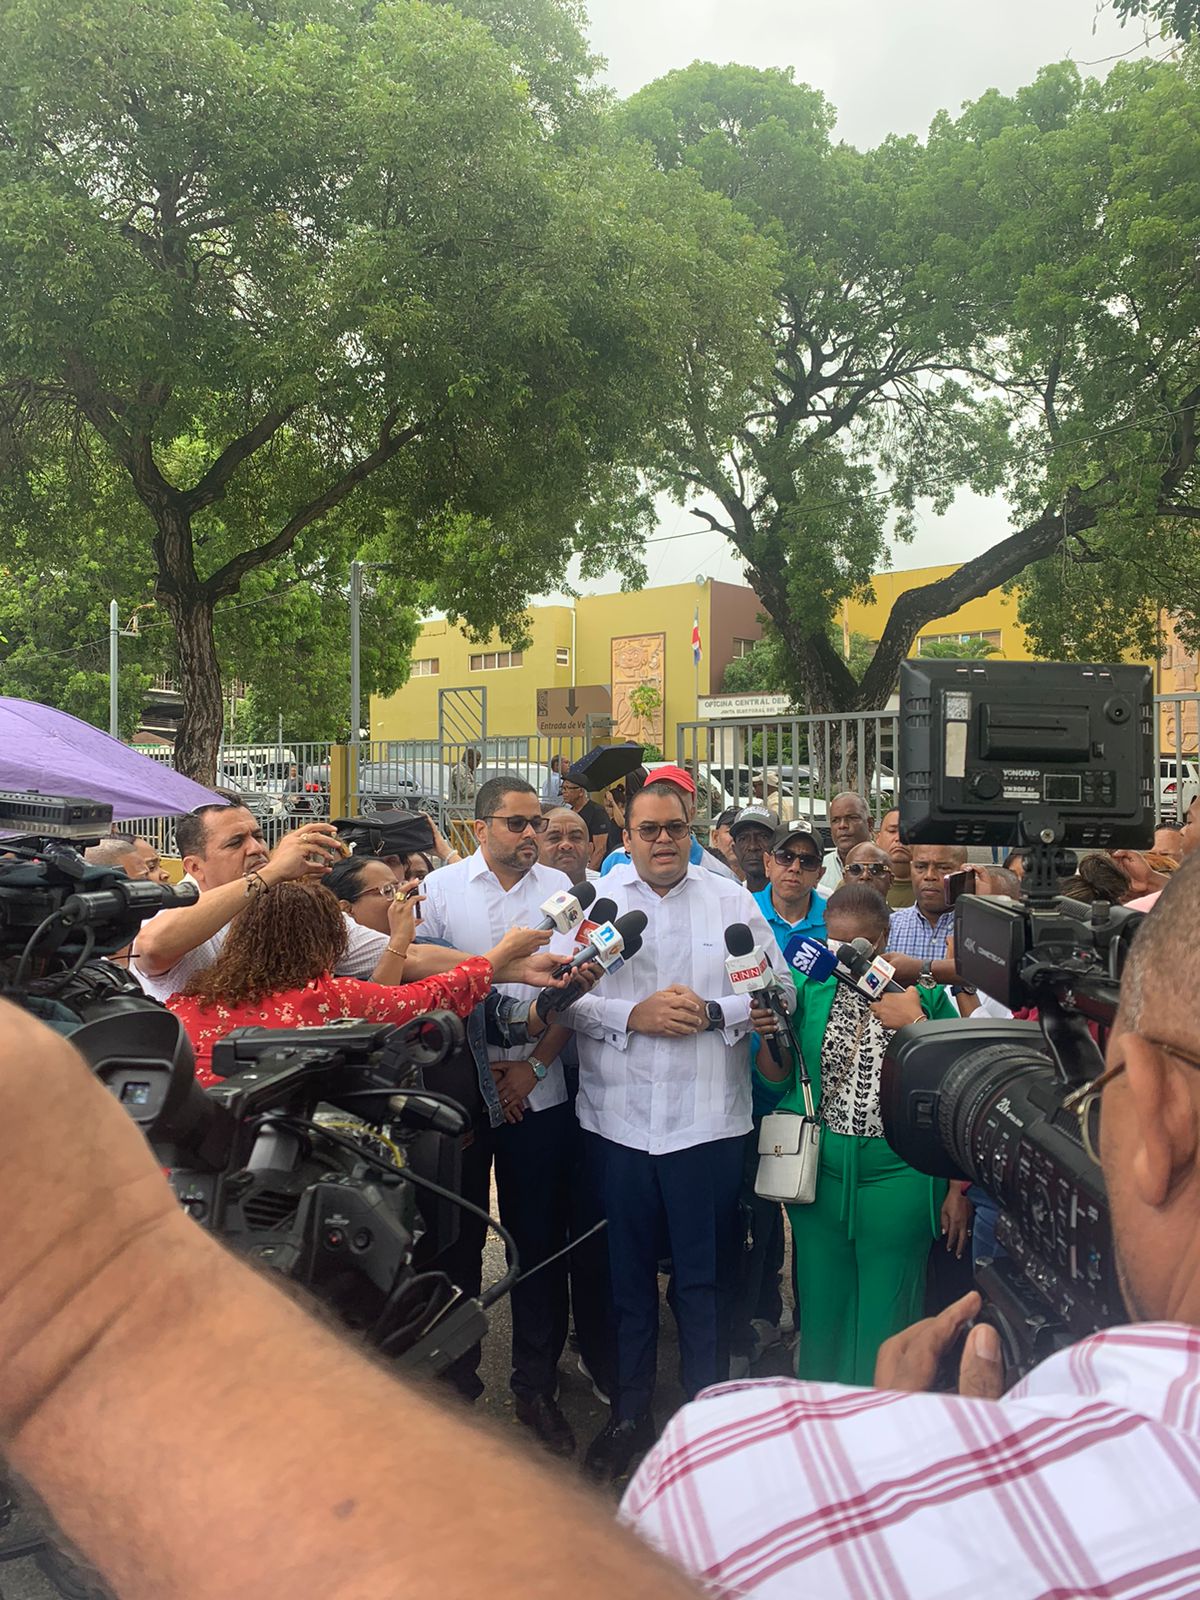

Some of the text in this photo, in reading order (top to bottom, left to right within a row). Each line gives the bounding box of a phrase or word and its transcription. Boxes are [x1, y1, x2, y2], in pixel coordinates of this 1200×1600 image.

[704, 700, 733, 708] OFICINA
[735, 697, 770, 706] CENTRAL
[540, 721, 567, 730] Entrada
[568, 721, 576, 729] de
[1002, 769, 1041, 777] YONGNUO
[792, 941, 818, 971] SM
[732, 969, 760, 981] RNN
